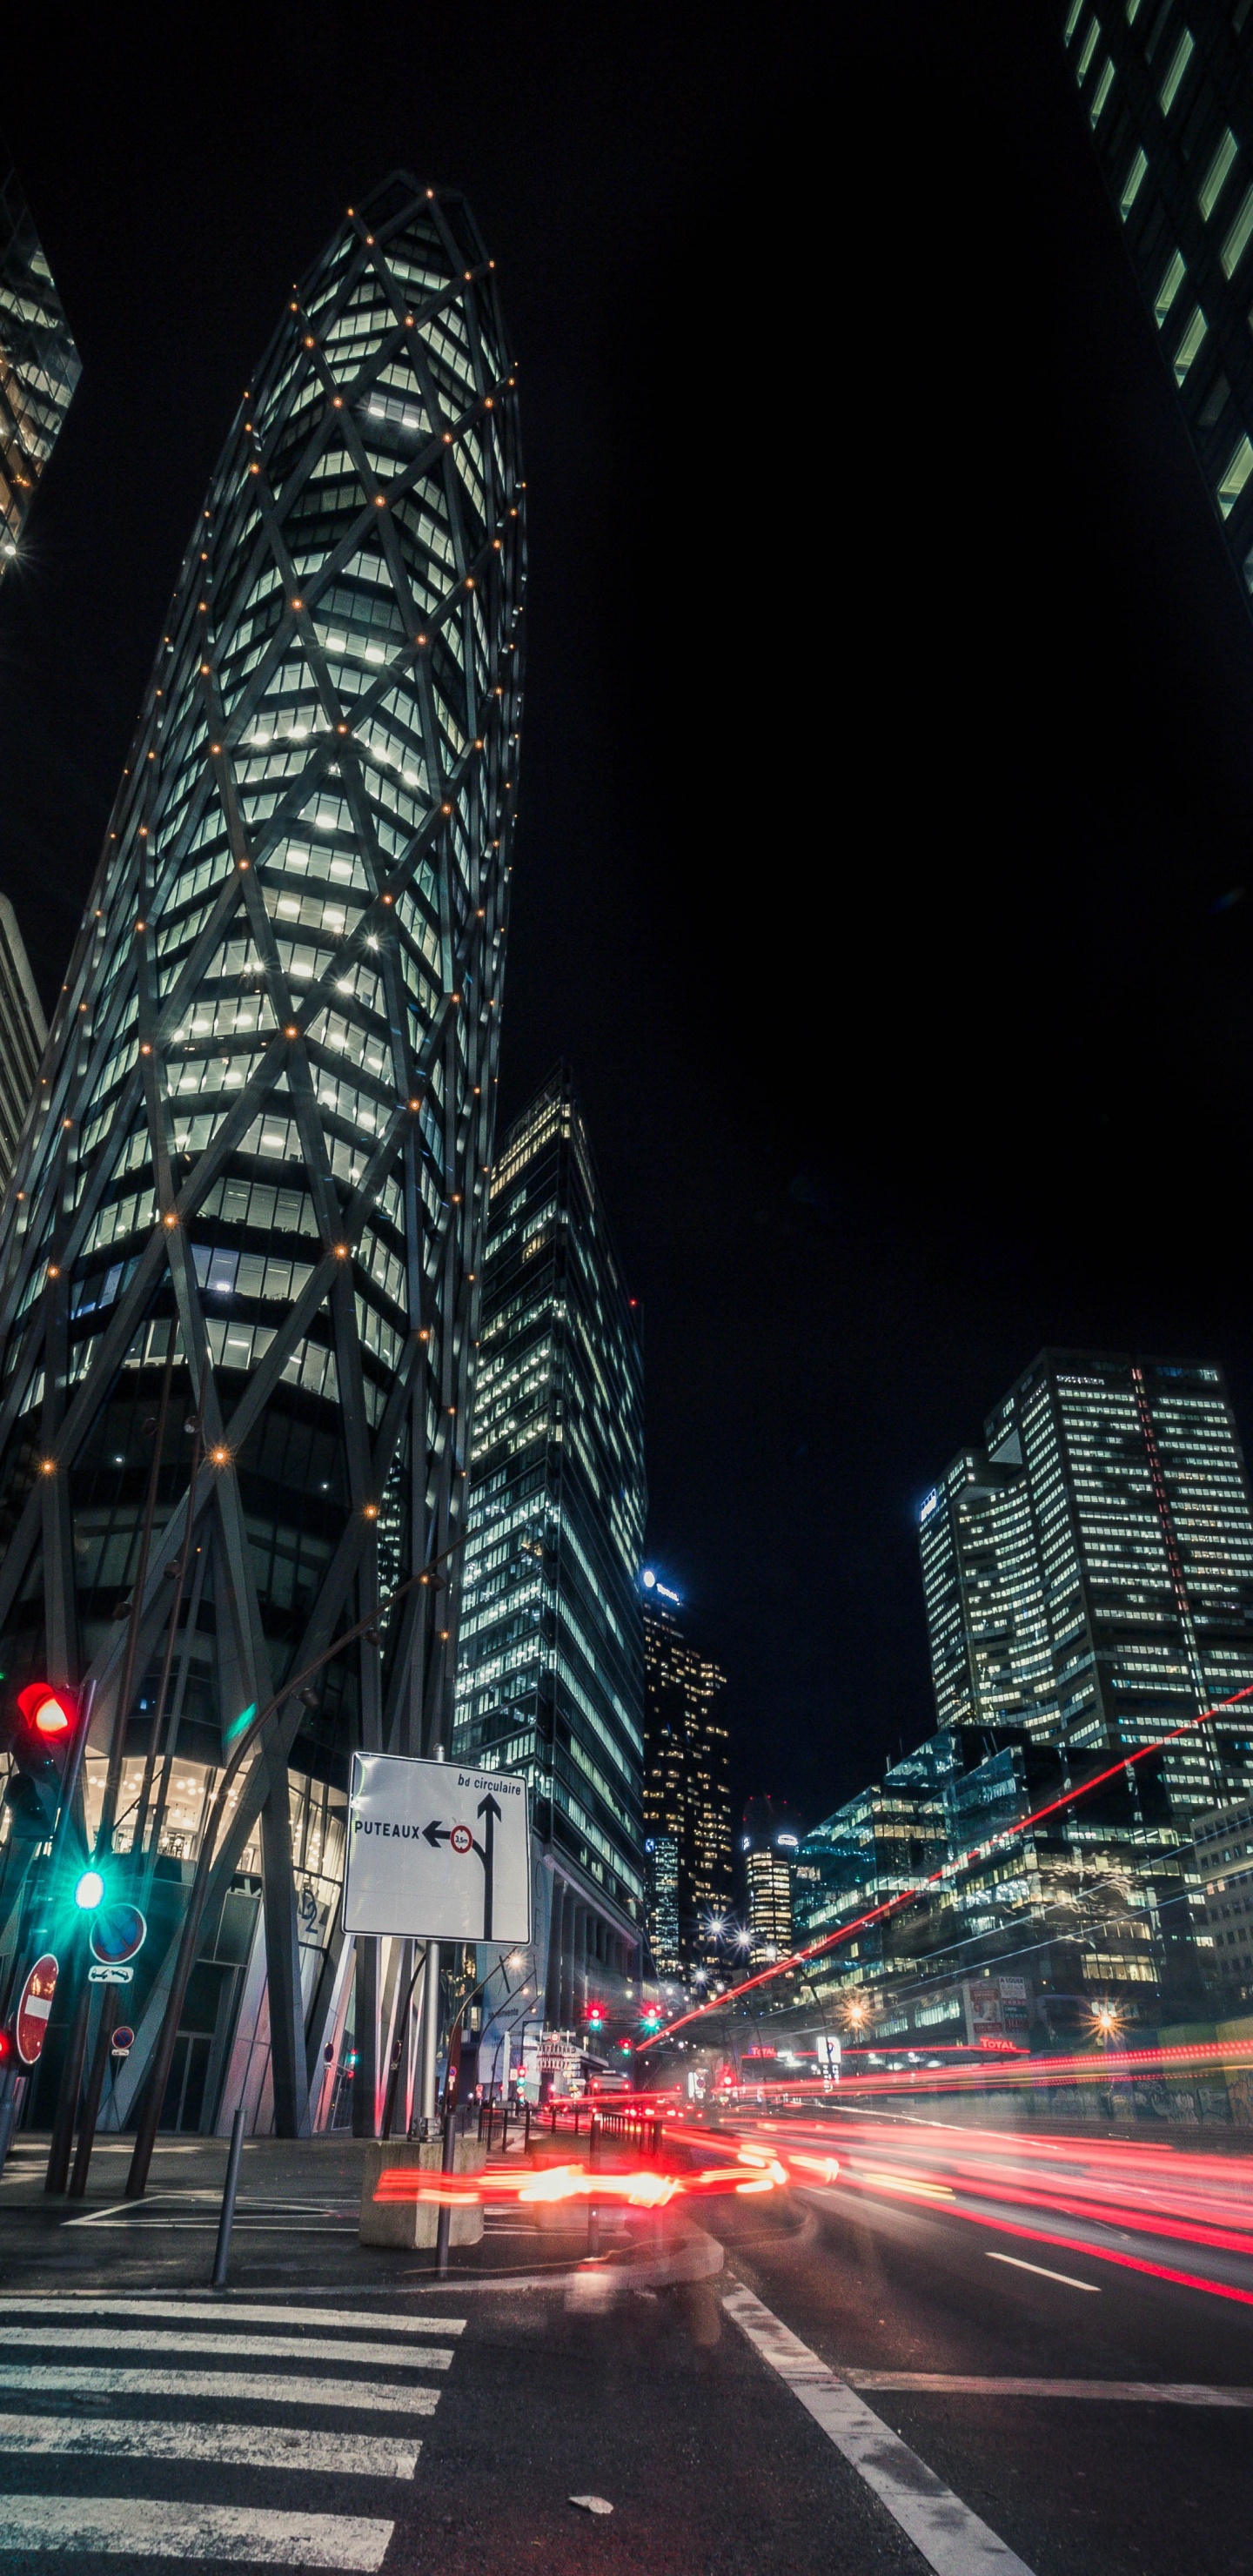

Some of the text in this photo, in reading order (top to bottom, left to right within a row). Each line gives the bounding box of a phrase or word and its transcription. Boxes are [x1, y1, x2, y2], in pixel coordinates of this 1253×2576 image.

[458, 1774, 522, 1795] bd circulaire
[353, 1821, 420, 1839] PUTEAUX
[751, 2046, 777, 2056] TOTAL
[980, 2036, 1017, 2050] TOTAL
